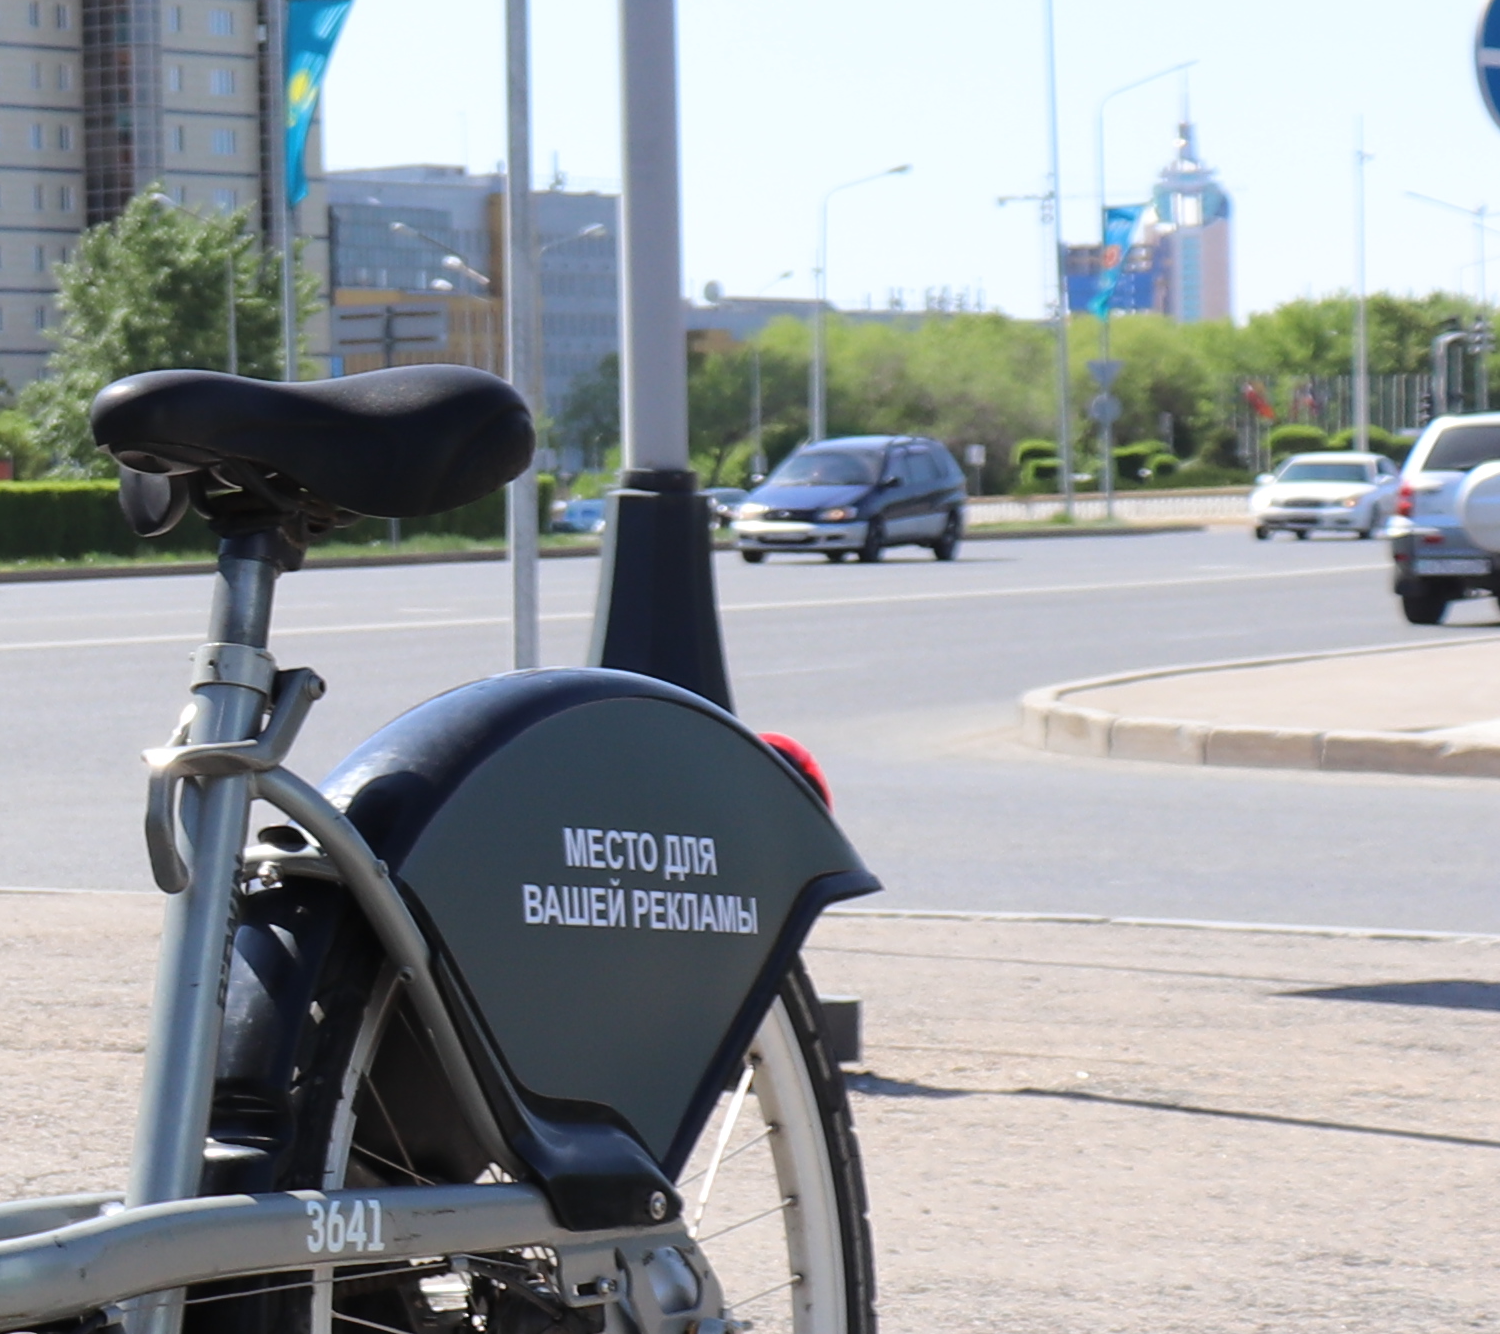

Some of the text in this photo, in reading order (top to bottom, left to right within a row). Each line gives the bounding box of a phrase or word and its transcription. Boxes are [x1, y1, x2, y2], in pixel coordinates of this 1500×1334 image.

[563, 826, 717, 881] МЕСТО ДЛЯ
[522, 879, 758, 935] ВАШЕЙ РЕКЛАМЫ
[305, 1200, 386, 1253] 3641
